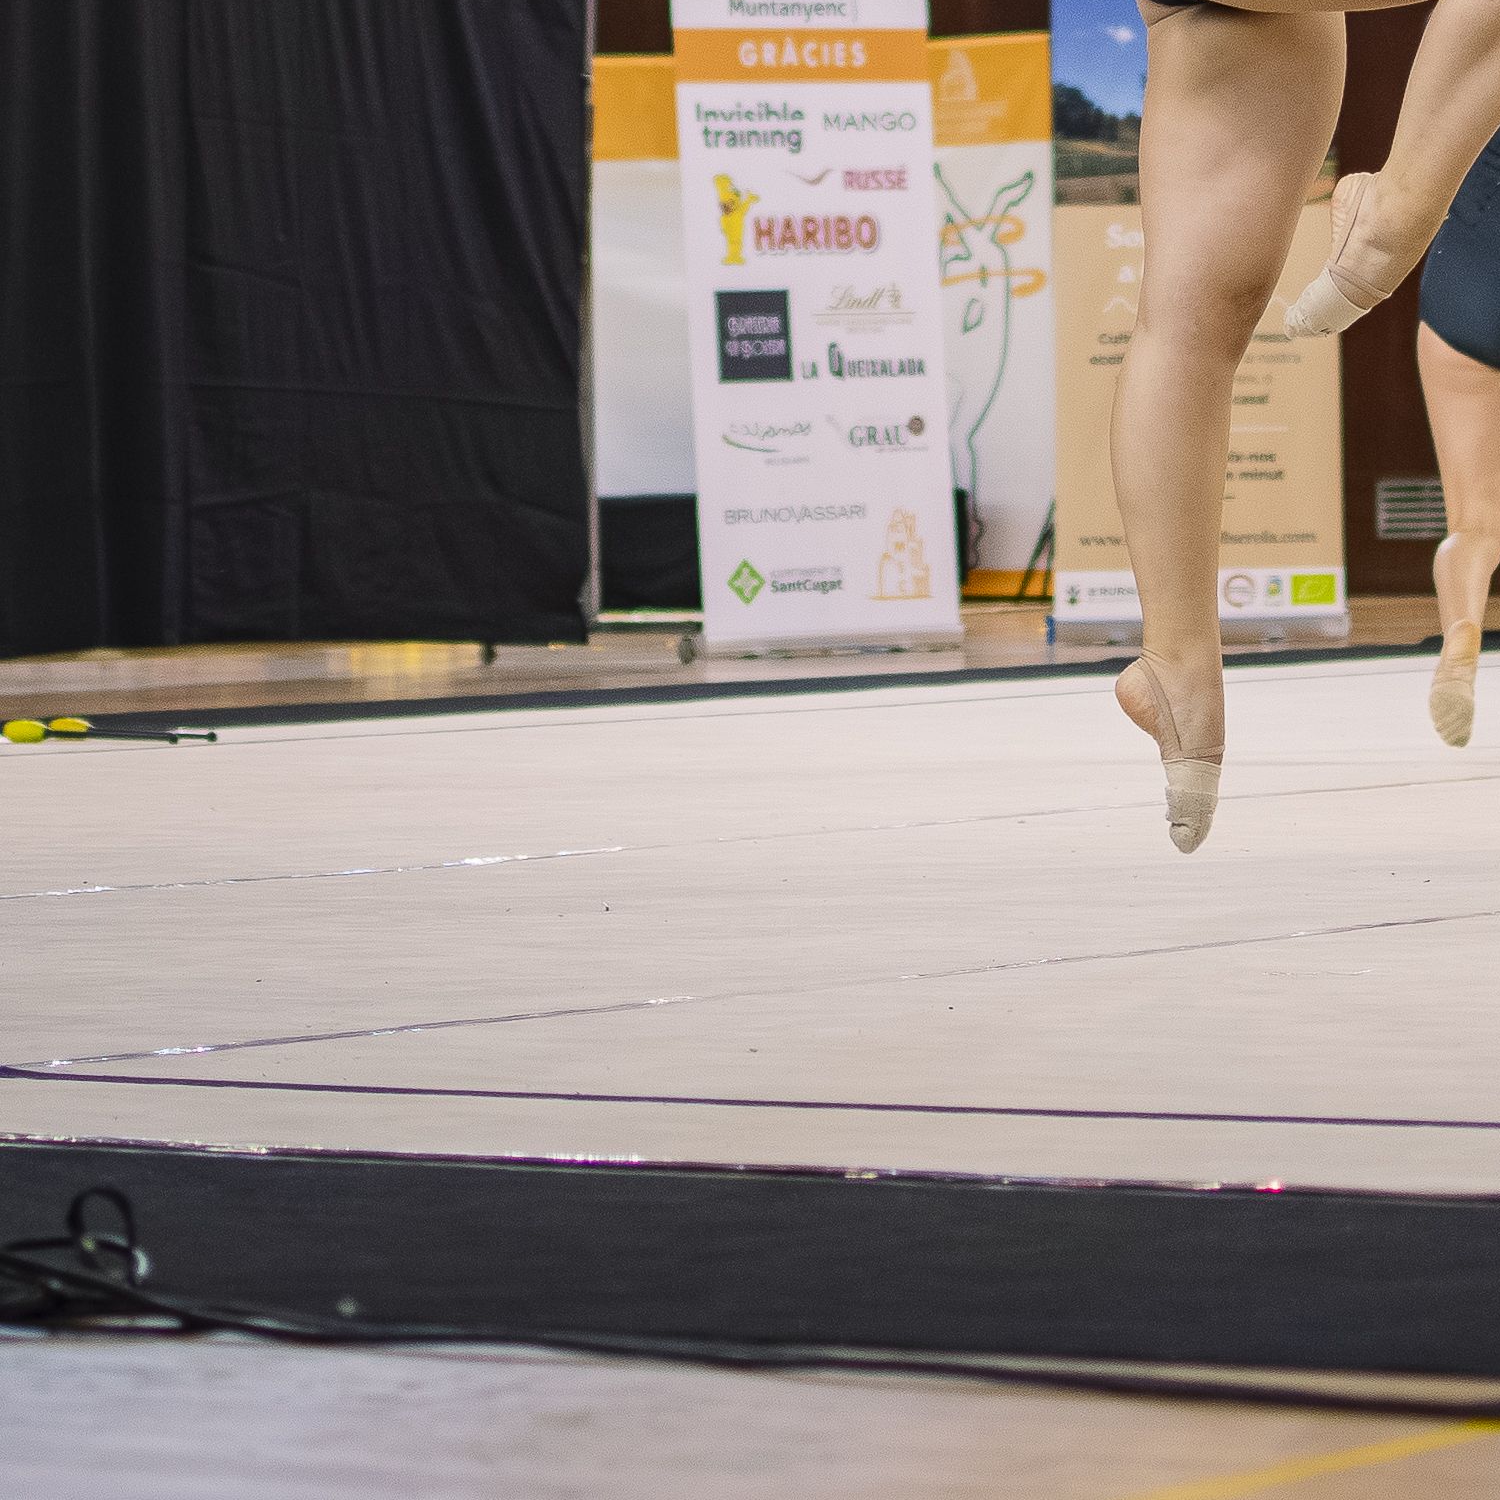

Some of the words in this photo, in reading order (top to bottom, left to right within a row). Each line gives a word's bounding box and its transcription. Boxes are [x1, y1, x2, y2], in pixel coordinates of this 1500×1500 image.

[823, 111, 917, 132] MANGO
[703, 124, 803, 154] training
[753, 214, 881, 253] HARIBO
[828, 284, 885, 311] Lindt
[802, 360, 819, 380] LA
